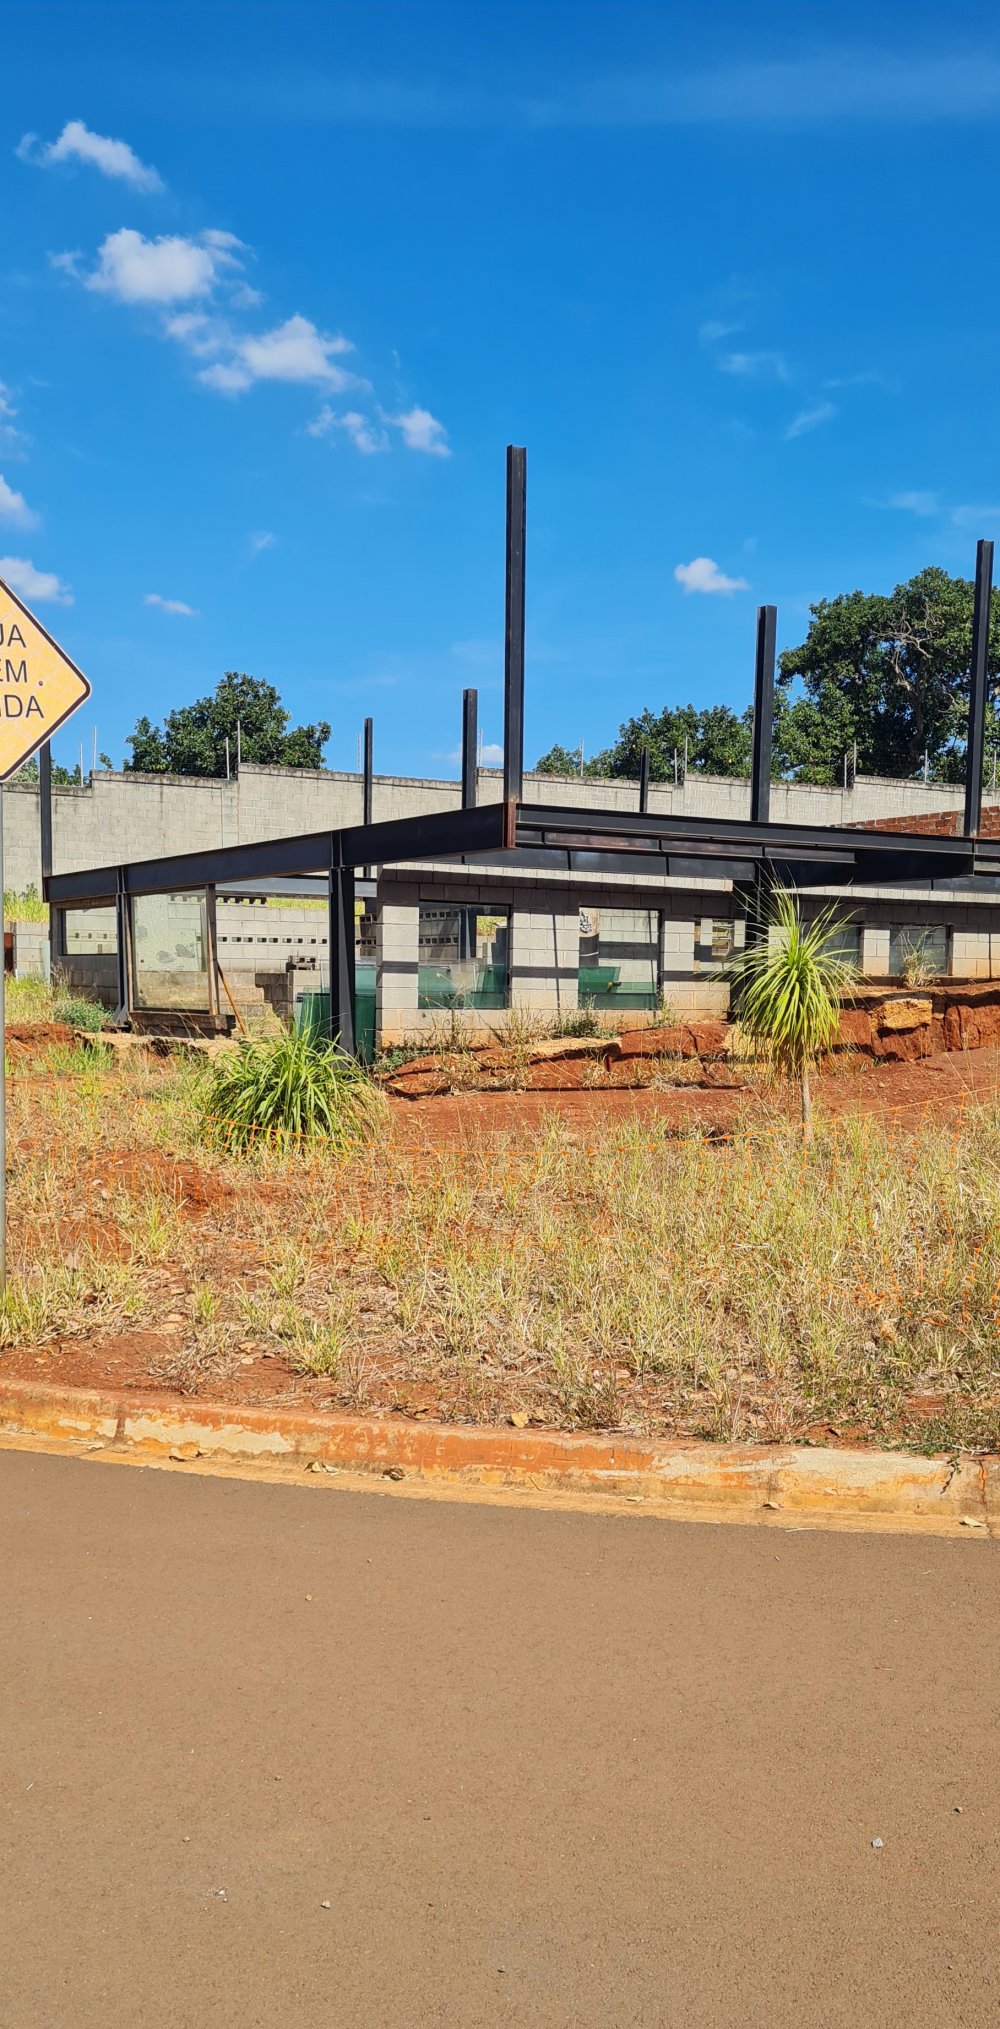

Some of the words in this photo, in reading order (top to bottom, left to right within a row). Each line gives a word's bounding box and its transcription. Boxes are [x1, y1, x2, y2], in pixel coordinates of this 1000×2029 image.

[0, 623, 27, 648] A
[0, 659, 27, 683] M
[0, 694, 45, 719] DA
